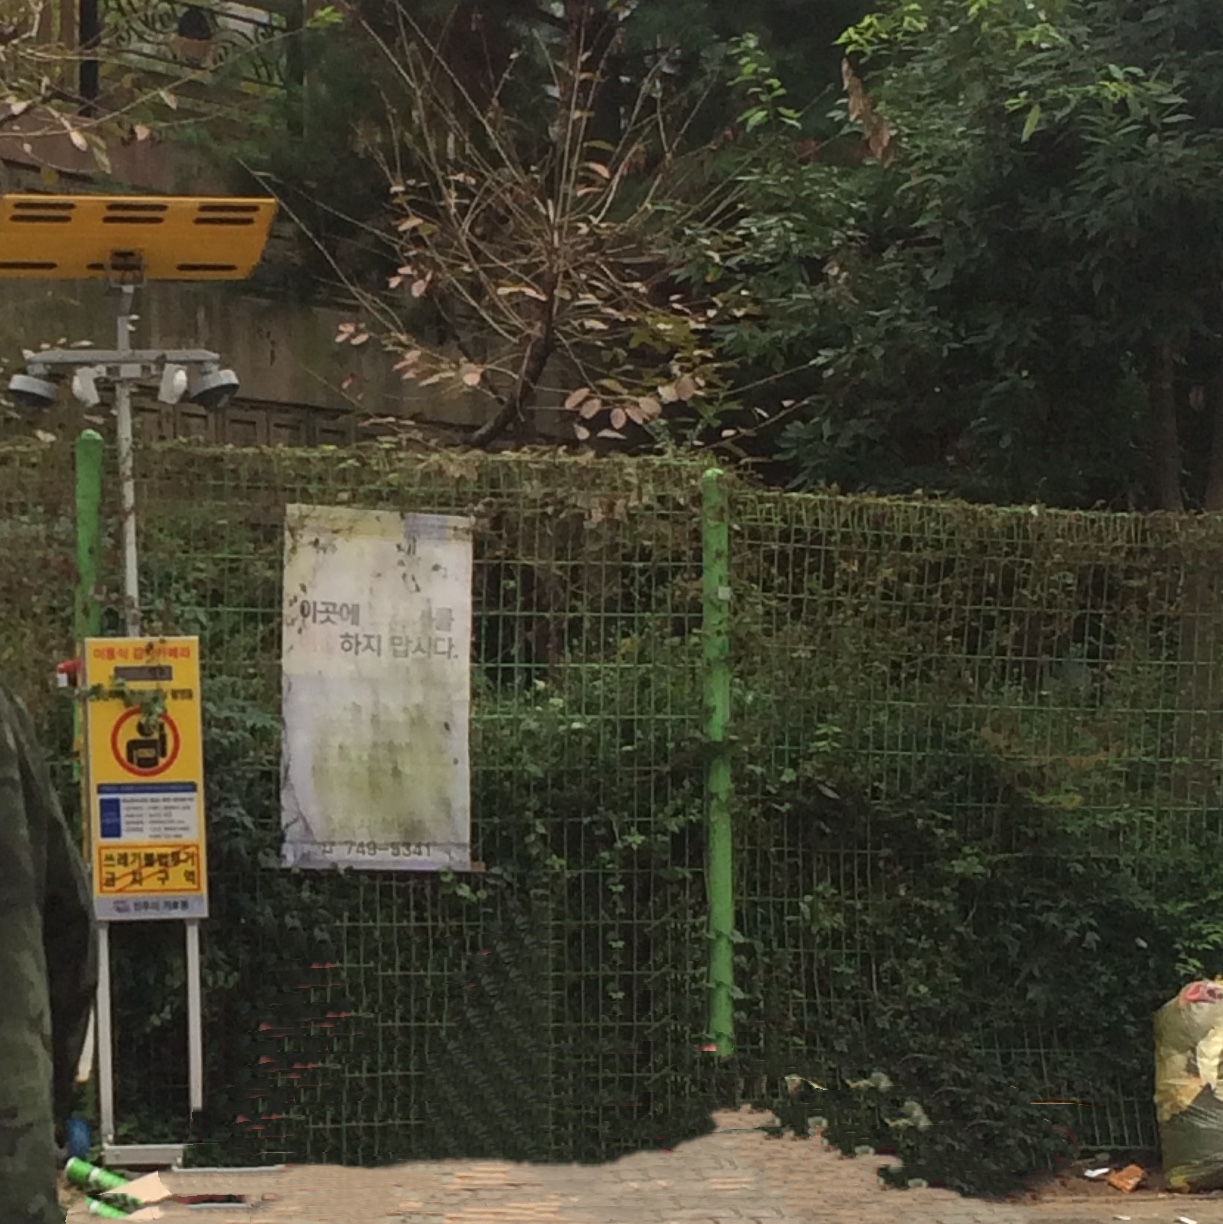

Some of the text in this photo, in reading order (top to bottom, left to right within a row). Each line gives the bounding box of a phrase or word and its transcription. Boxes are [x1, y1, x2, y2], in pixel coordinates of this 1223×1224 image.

[299, 599, 360, 627] 이곳에
[133, 646, 191, 660] 감카메라
[339, 632, 382, 657] 하지
